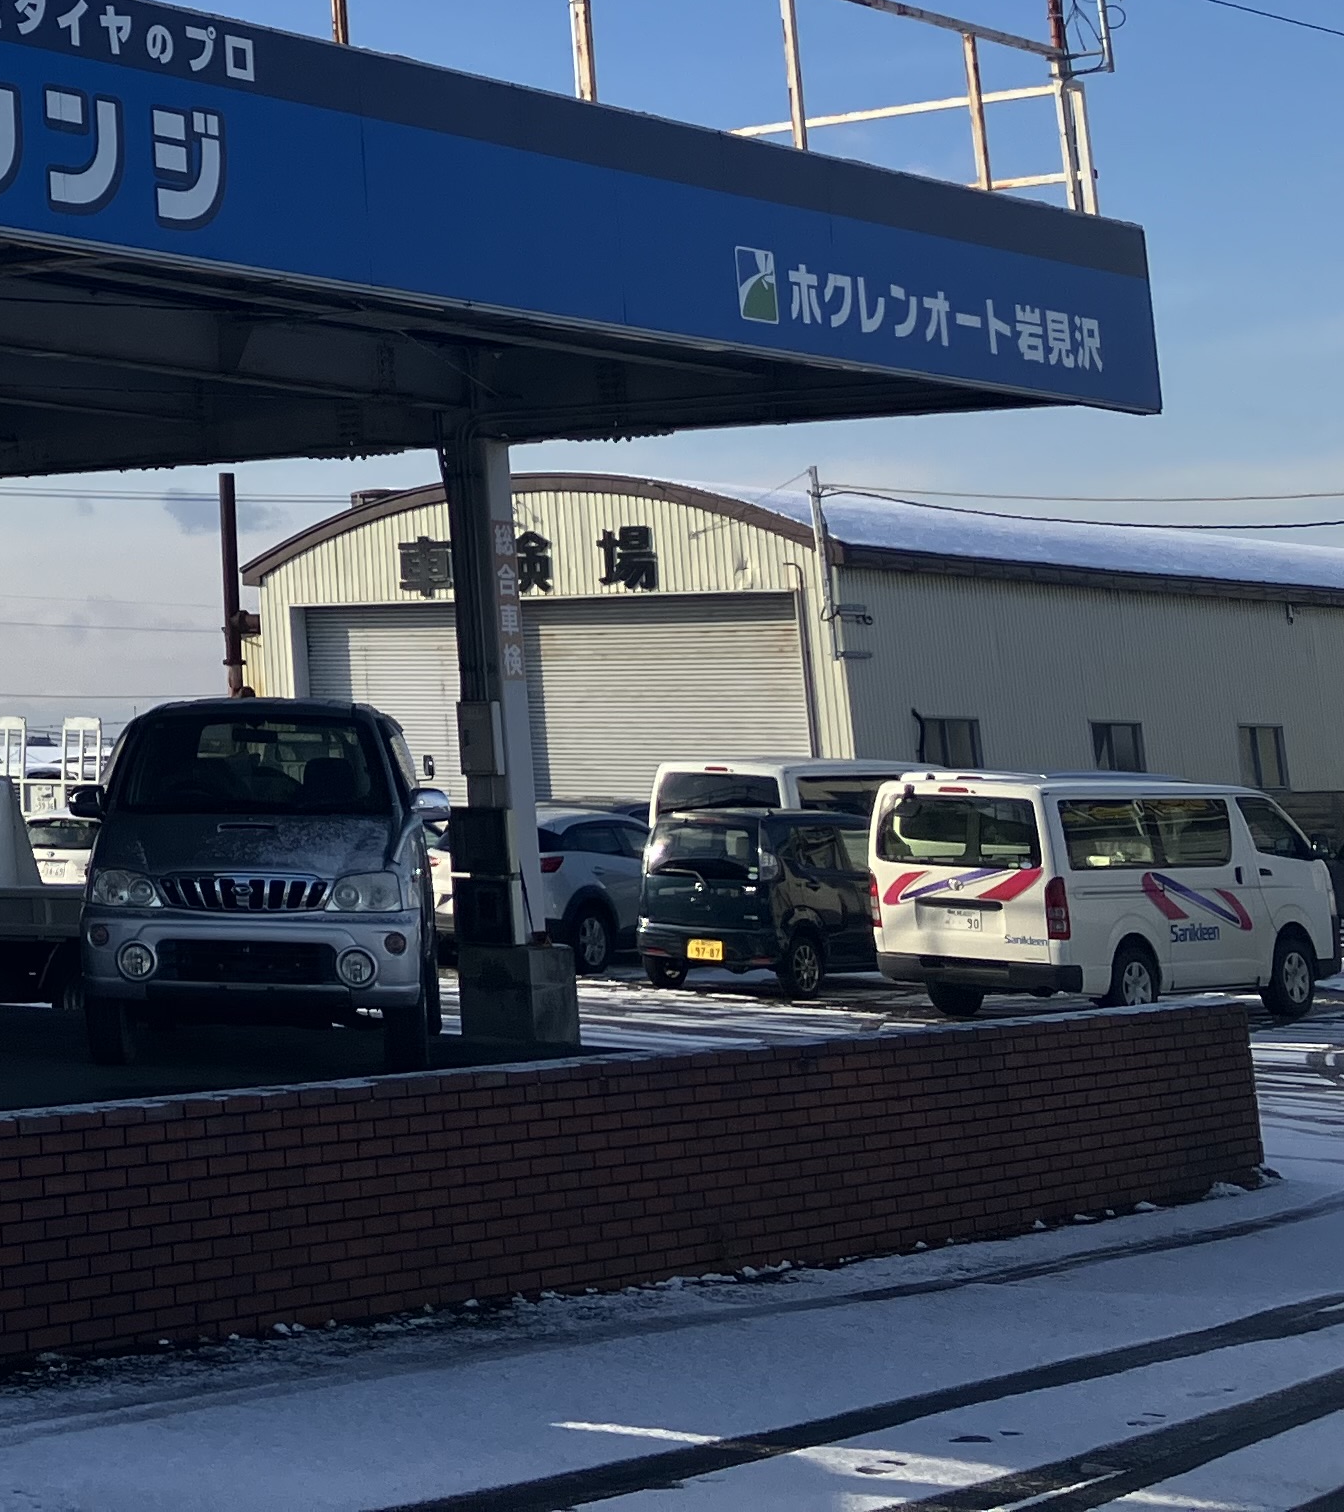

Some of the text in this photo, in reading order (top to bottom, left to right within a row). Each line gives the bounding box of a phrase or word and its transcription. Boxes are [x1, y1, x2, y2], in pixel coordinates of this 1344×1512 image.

[787, 263, 1104, 374] ホクレンオート岩見沢
[494, 524, 523, 676] 総合車検
[1169, 922, 1221, 944] Sanikleen
